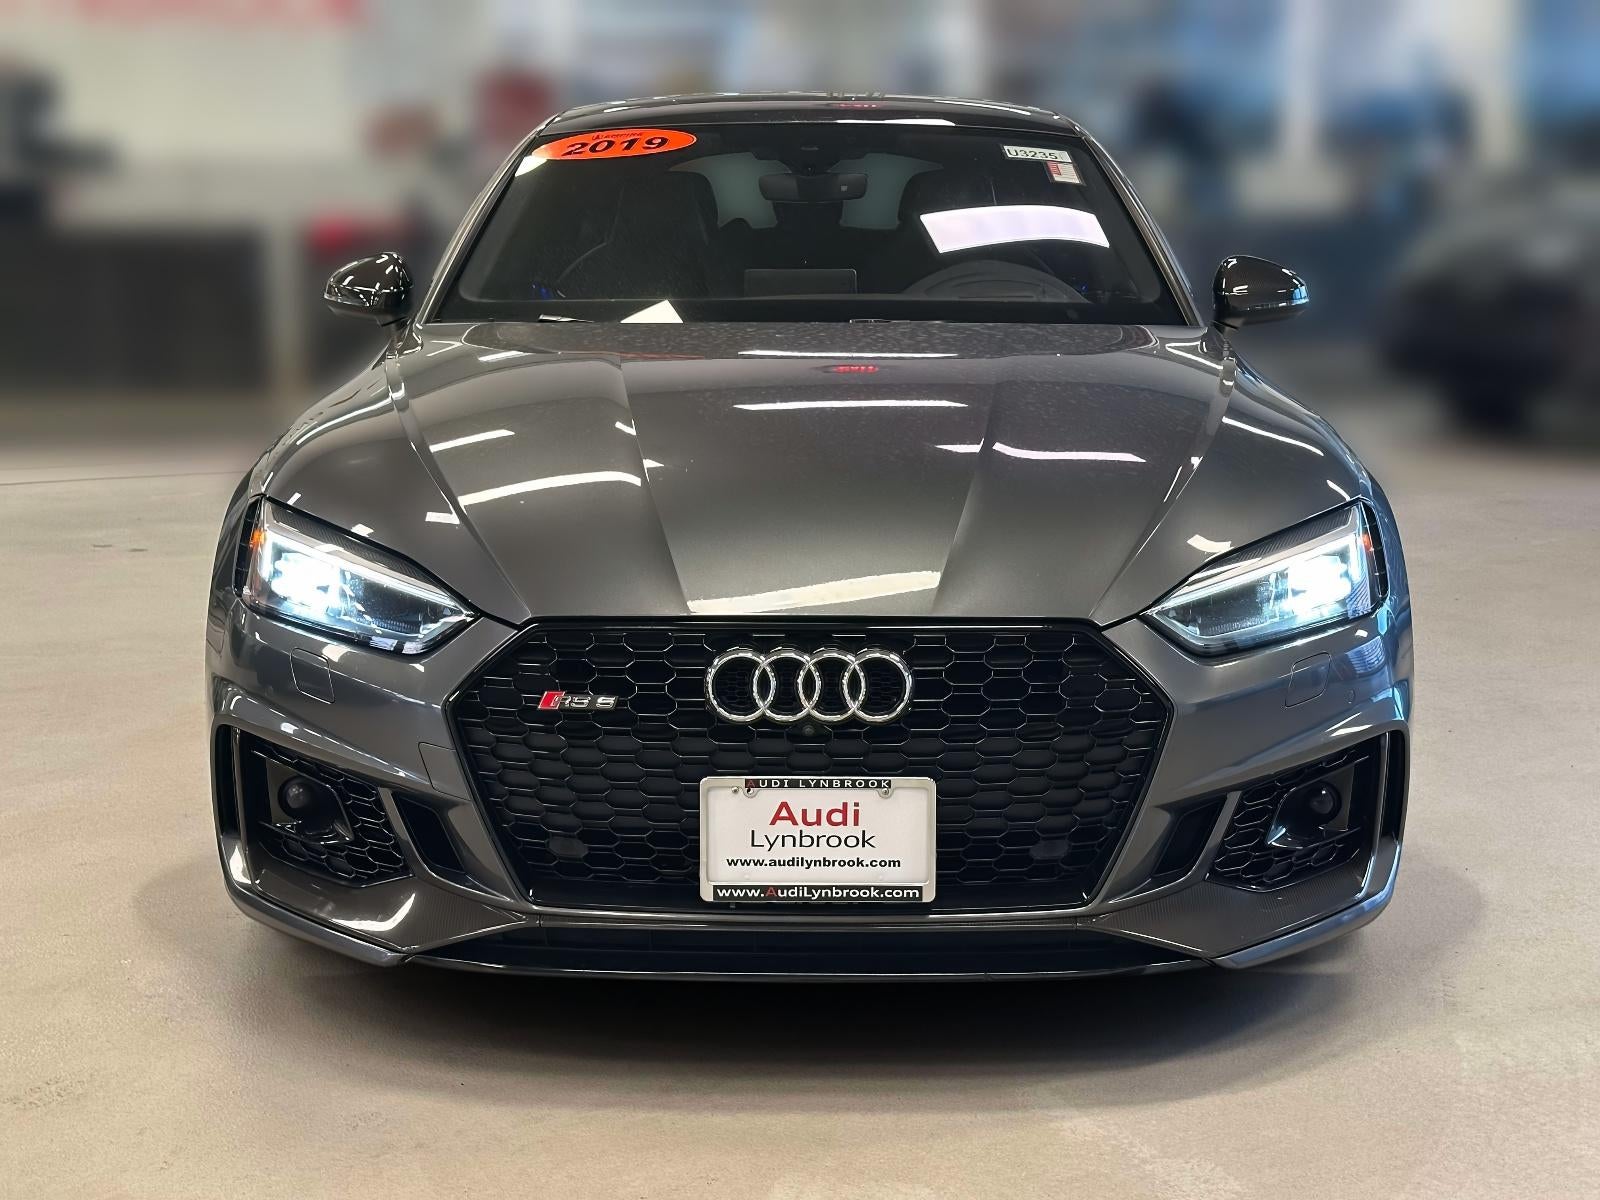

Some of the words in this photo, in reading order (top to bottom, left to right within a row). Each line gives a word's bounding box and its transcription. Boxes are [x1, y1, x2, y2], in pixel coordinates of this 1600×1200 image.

[561, 136, 670, 156] 2019
[1006, 148, 1058, 160] U3235
[747, 779, 790, 788] AUDI
[799, 779, 891, 788] LYNBROOK
[769, 801, 860, 827] Audi
[751, 829, 876, 852] Lynbrook
[726, 857, 901, 869] www.audilynbrook.com
[717, 886, 920, 900] www.AudiLynbrook.com
